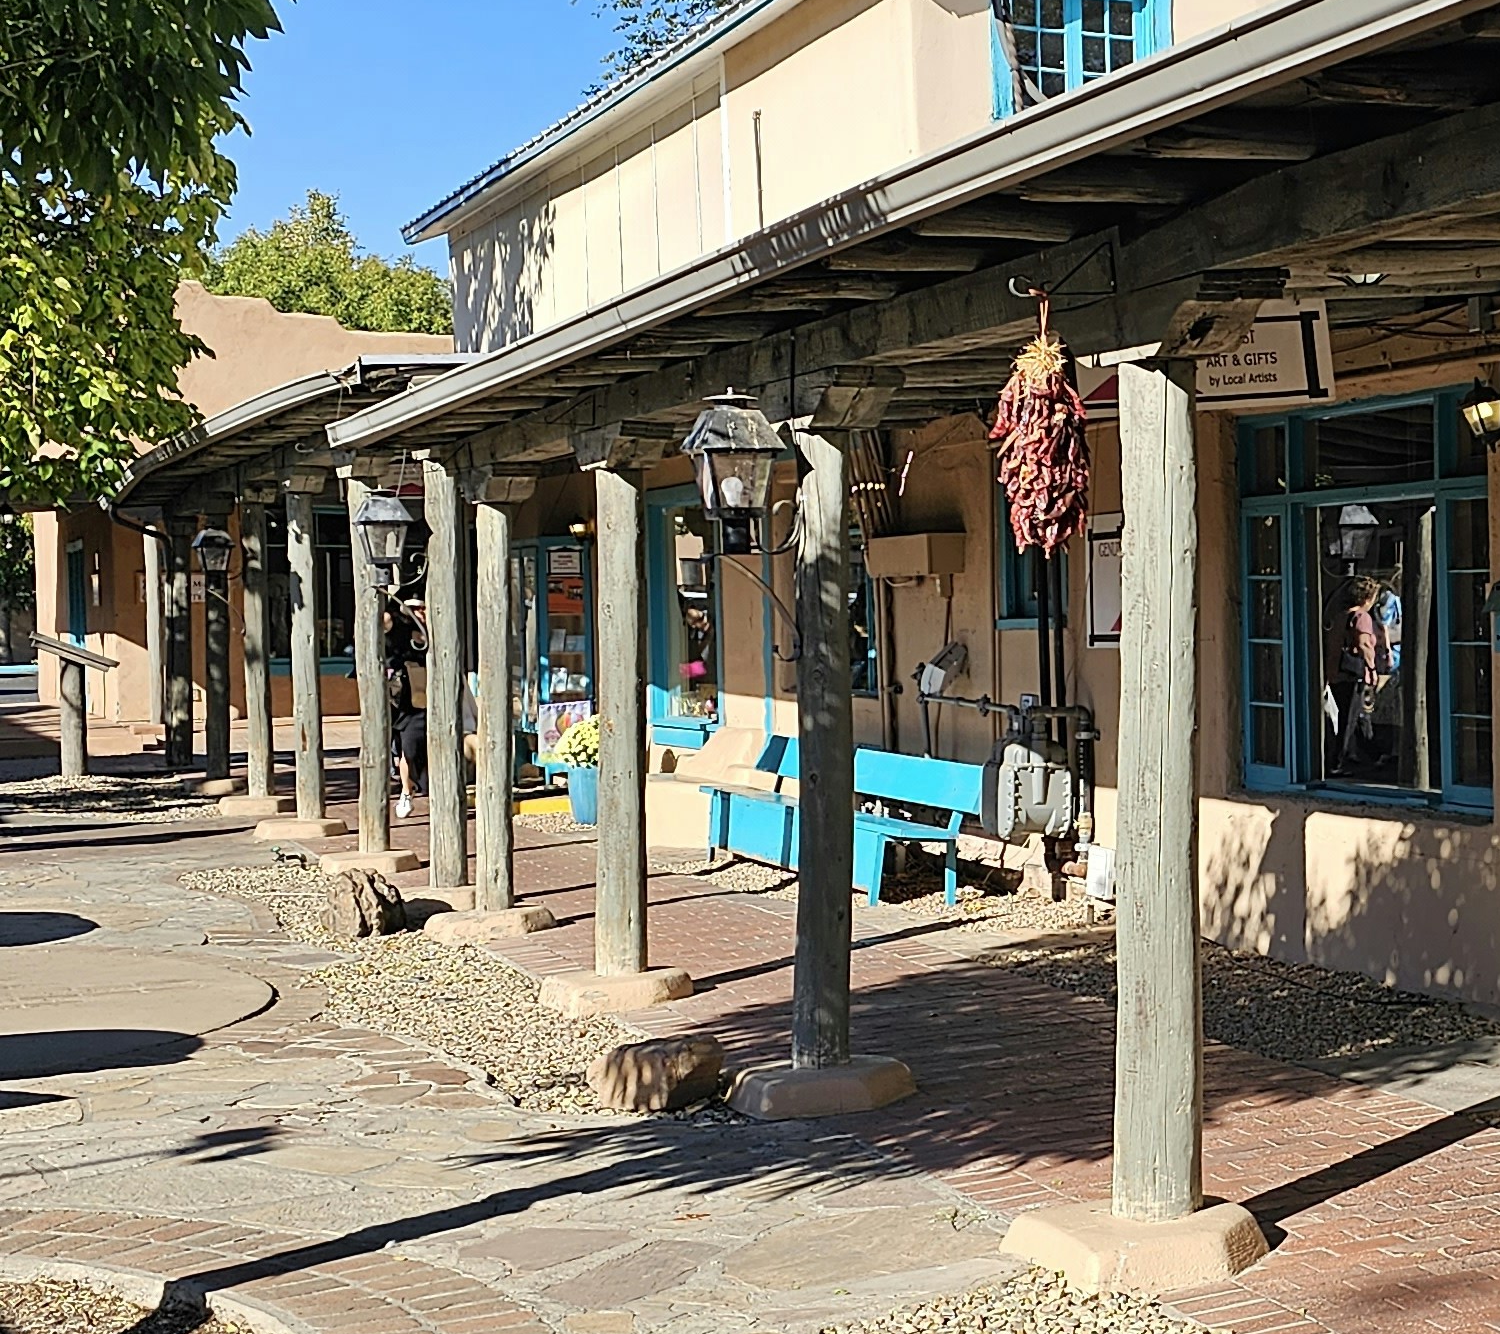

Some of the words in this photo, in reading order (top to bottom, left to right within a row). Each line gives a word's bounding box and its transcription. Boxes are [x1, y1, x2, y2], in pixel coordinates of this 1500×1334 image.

[1206, 354, 1228, 368] ART
[1232, 353, 1241, 366] &
[1244, 352, 1277, 365] GIFTS
[1209, 375, 1221, 388] by
[1223, 373, 1246, 385] Local
[1249, 373, 1277, 383] Artists
